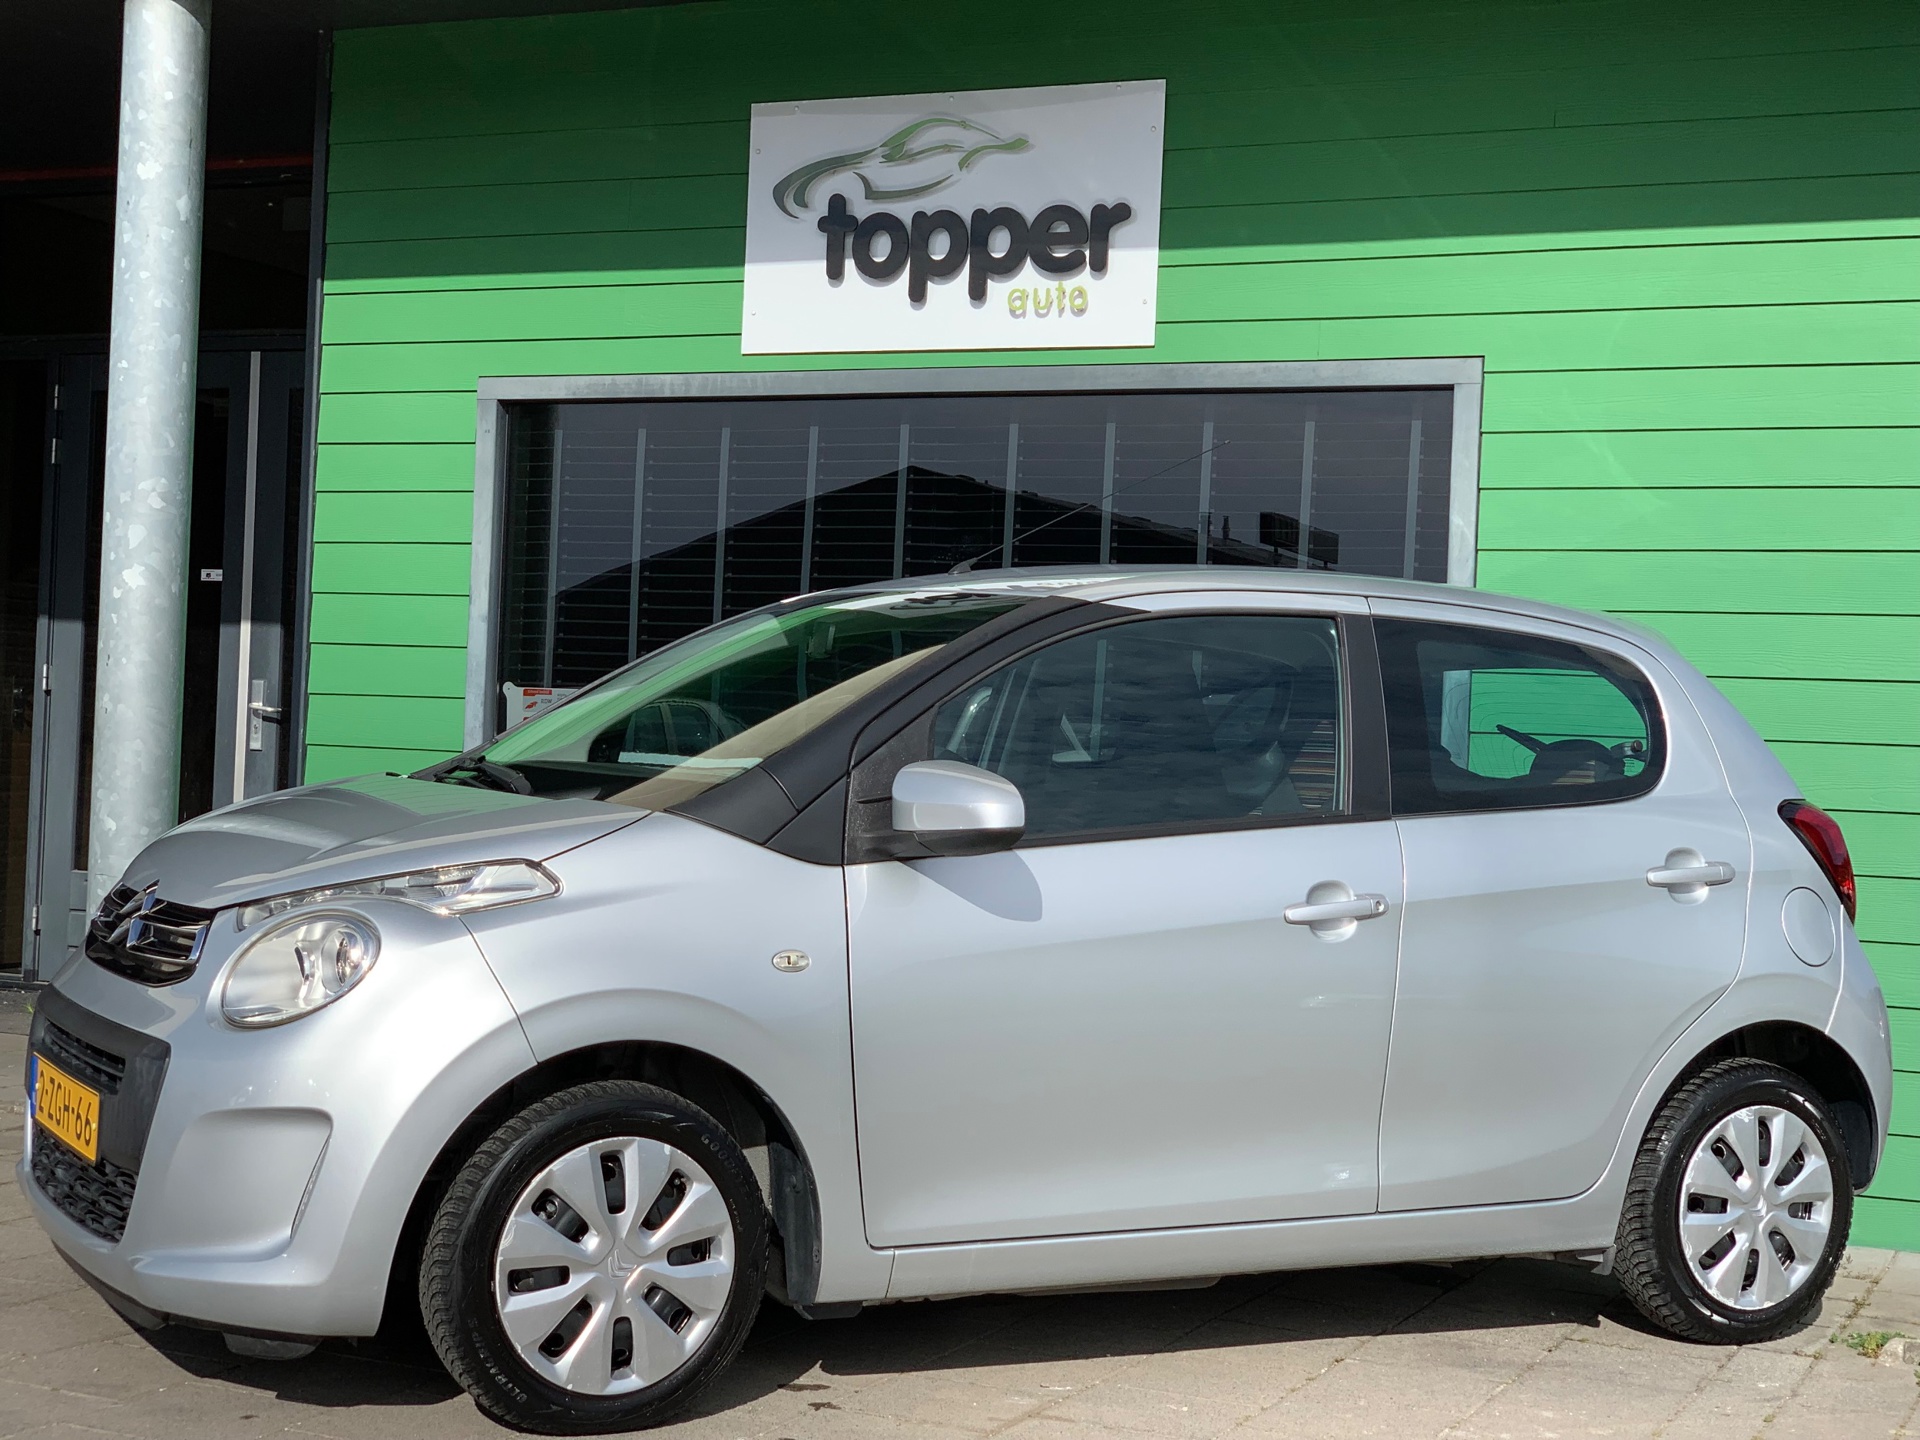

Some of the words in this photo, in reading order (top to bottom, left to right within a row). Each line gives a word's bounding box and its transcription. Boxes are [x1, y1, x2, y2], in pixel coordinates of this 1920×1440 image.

[817, 193, 1132, 303] topper
[1007, 281, 1088, 312] auto
[38, 1069, 92, 1147] 2-ZGH-66
